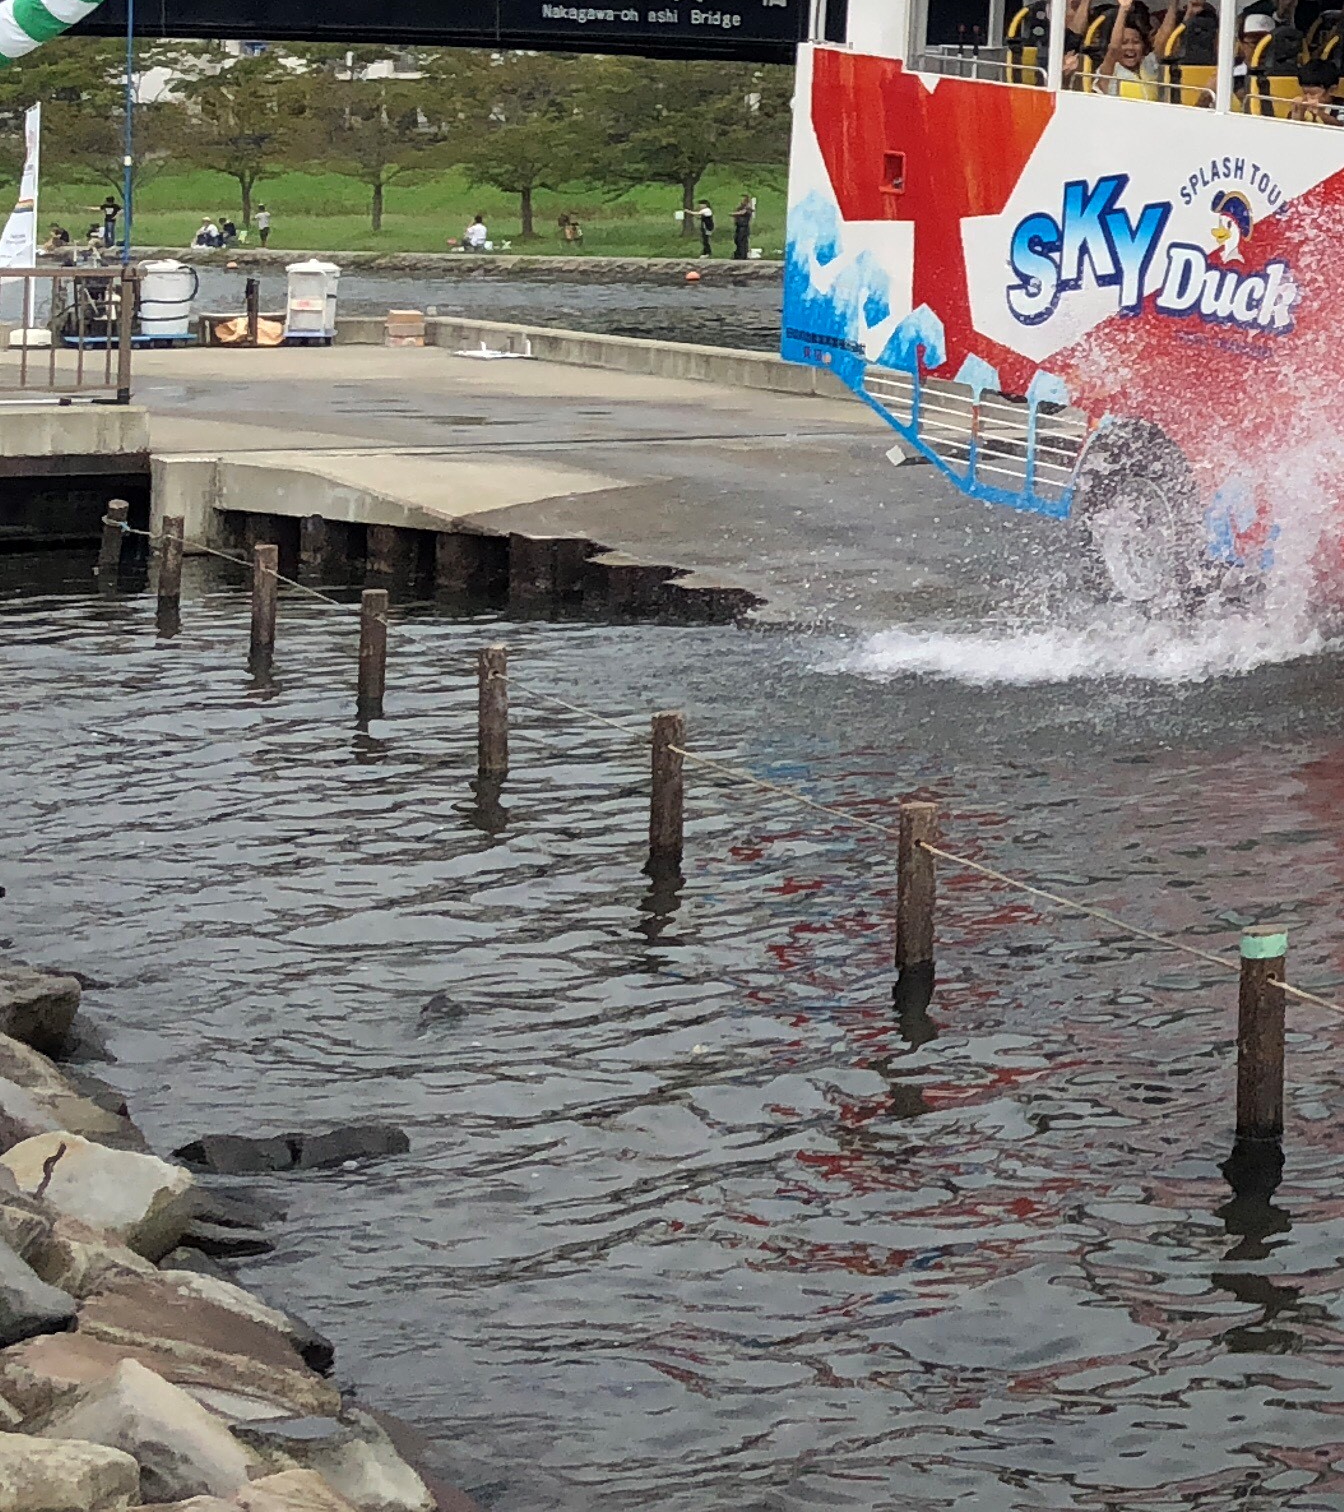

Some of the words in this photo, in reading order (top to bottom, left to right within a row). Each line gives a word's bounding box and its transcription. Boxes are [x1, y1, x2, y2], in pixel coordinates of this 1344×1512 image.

[690, 10, 741, 28] Bridge
[1180, 157, 1246, 205] SPLASH
[1006, 174, 1173, 326] SKY
[1154, 242, 1298, 334] Duck
